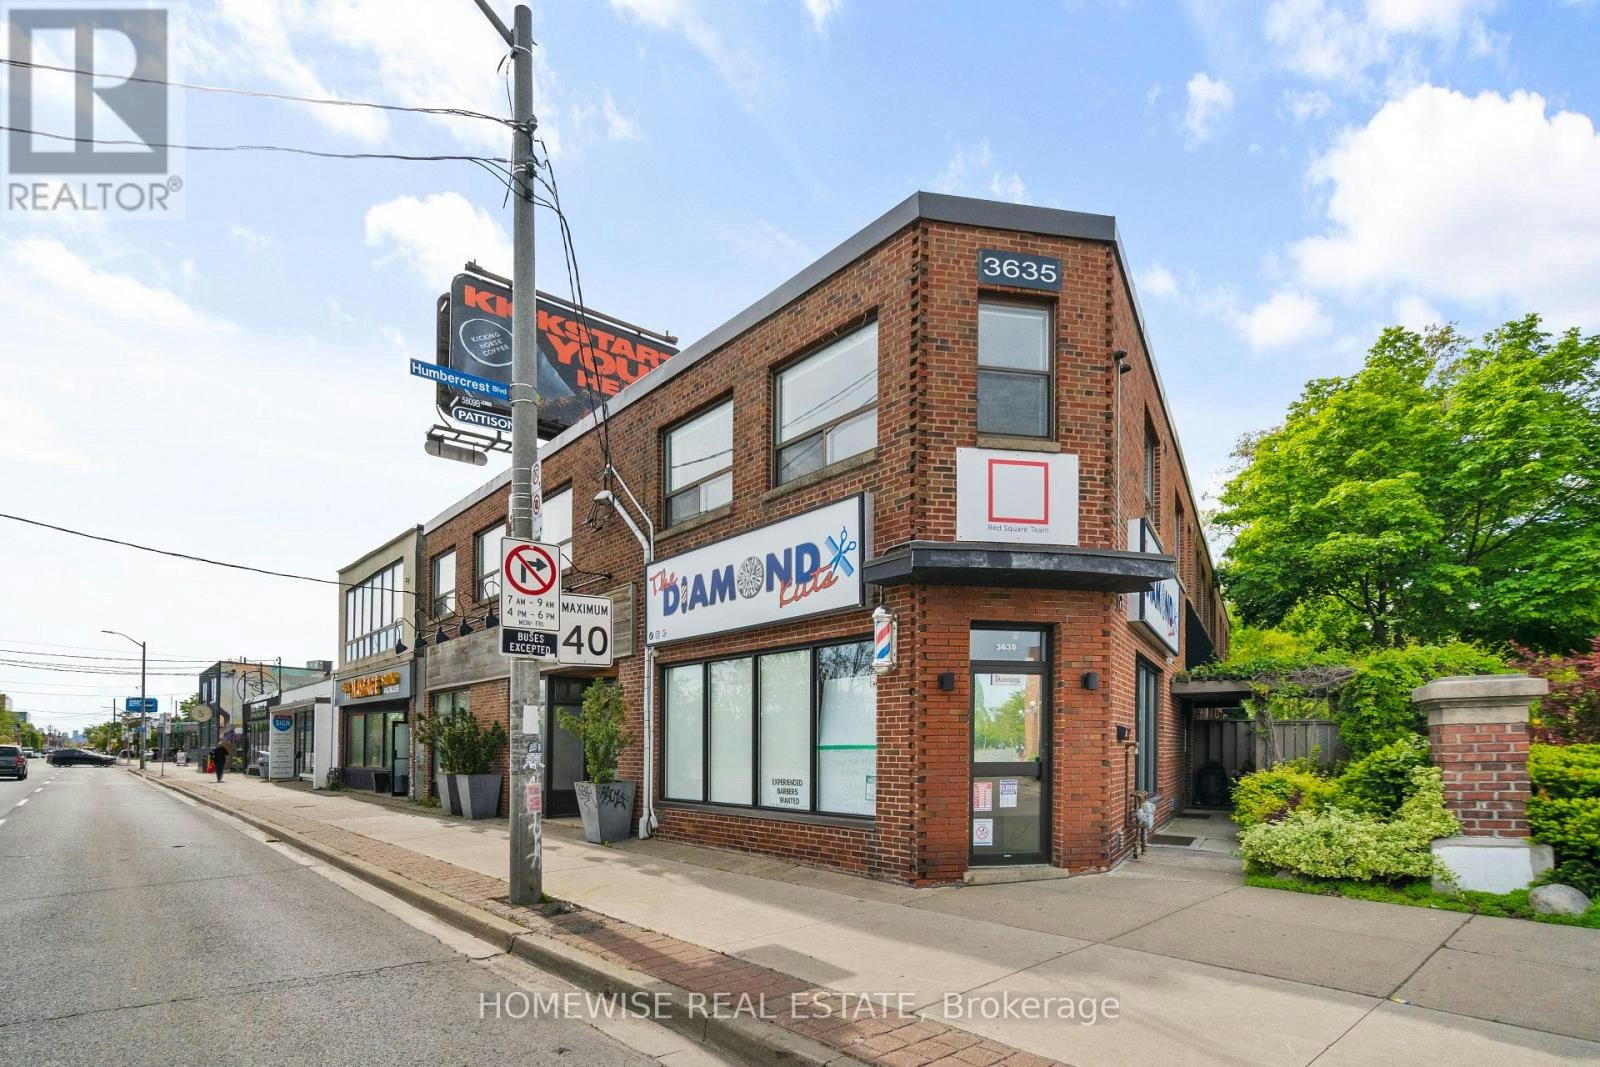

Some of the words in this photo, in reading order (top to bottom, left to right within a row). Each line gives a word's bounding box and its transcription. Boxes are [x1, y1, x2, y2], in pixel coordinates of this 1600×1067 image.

[983, 257, 1057, 283] 3635
[464, 284, 672, 368] KIKSTAR
[471, 331, 501, 343] KICKING
[479, 338, 503, 350] HORSE
[482, 344, 510, 357] COFFEE
[546, 333, 654, 384] YOU
[412, 362, 490, 393] Humbercrest
[492, 385, 507, 395] Blvd
[577, 370, 628, 396] HE
[987, 524, 1002, 532] Red
[1004, 525, 1028, 534] Square
[1030, 526, 1049, 534] Team
[649, 568, 679, 597] The
[507, 594, 513, 605] 7
[516, 598, 526, 606] AM
[537, 598, 543, 607] 9
[545, 601, 555, 609] AM
[507, 607, 513, 617] 4
[517, 610, 527, 618] PM
[537, 610, 544, 620] 6
[545, 612, 555, 620] PM
[561, 601, 609, 617] MAXIMUM
[517, 632, 545, 644] BUSES
[562, 624, 608, 657] 40
[509, 642, 551, 655] EXCEPTED
[995, 643, 1017, 652] 3635
[771, 778, 804, 787] EXPERIENCED
[776, 787, 799, 796] BARBERS
[779, 795, 800, 805] WANTED
